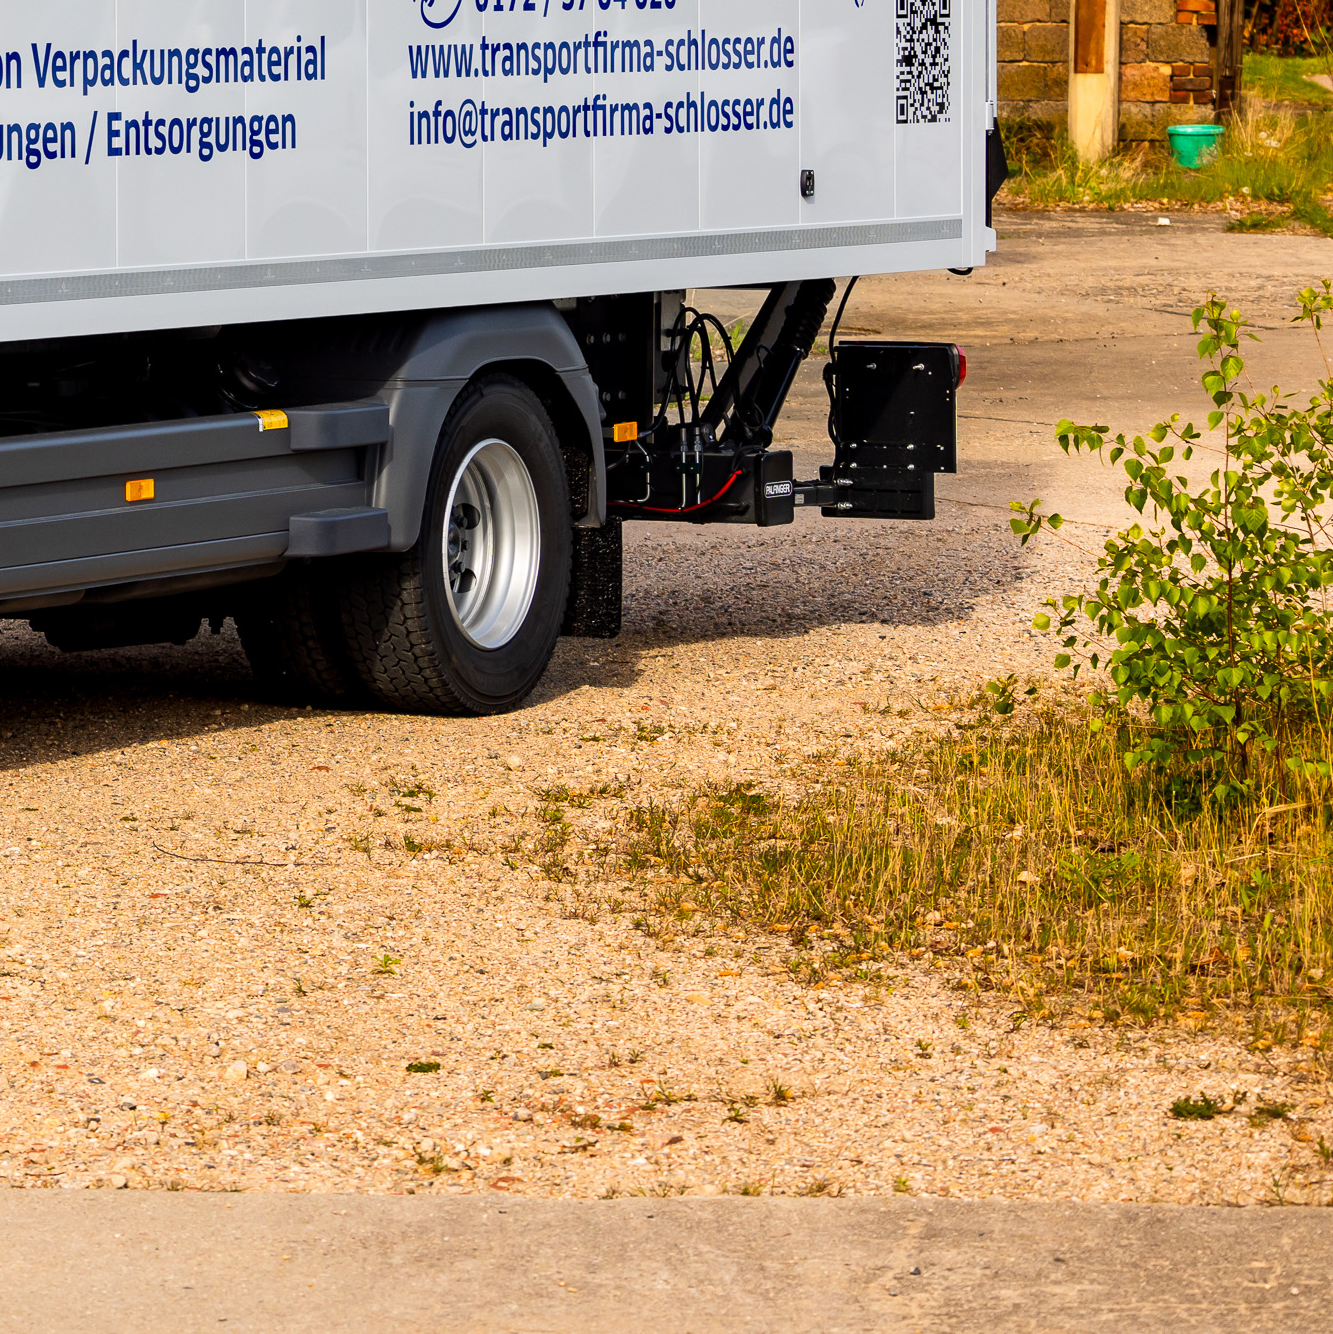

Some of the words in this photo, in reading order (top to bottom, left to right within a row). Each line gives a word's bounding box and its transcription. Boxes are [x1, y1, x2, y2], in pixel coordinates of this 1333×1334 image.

[31, 34, 326, 96] Verpackungsmaterial
[408, 27, 795, 84] www.transportfirma-schlosser.de
[84, 110, 99, 165] /
[106, 110, 296, 162] Entsorgungen
[409, 88, 794, 149] info@transportfirma-schlosser.de
